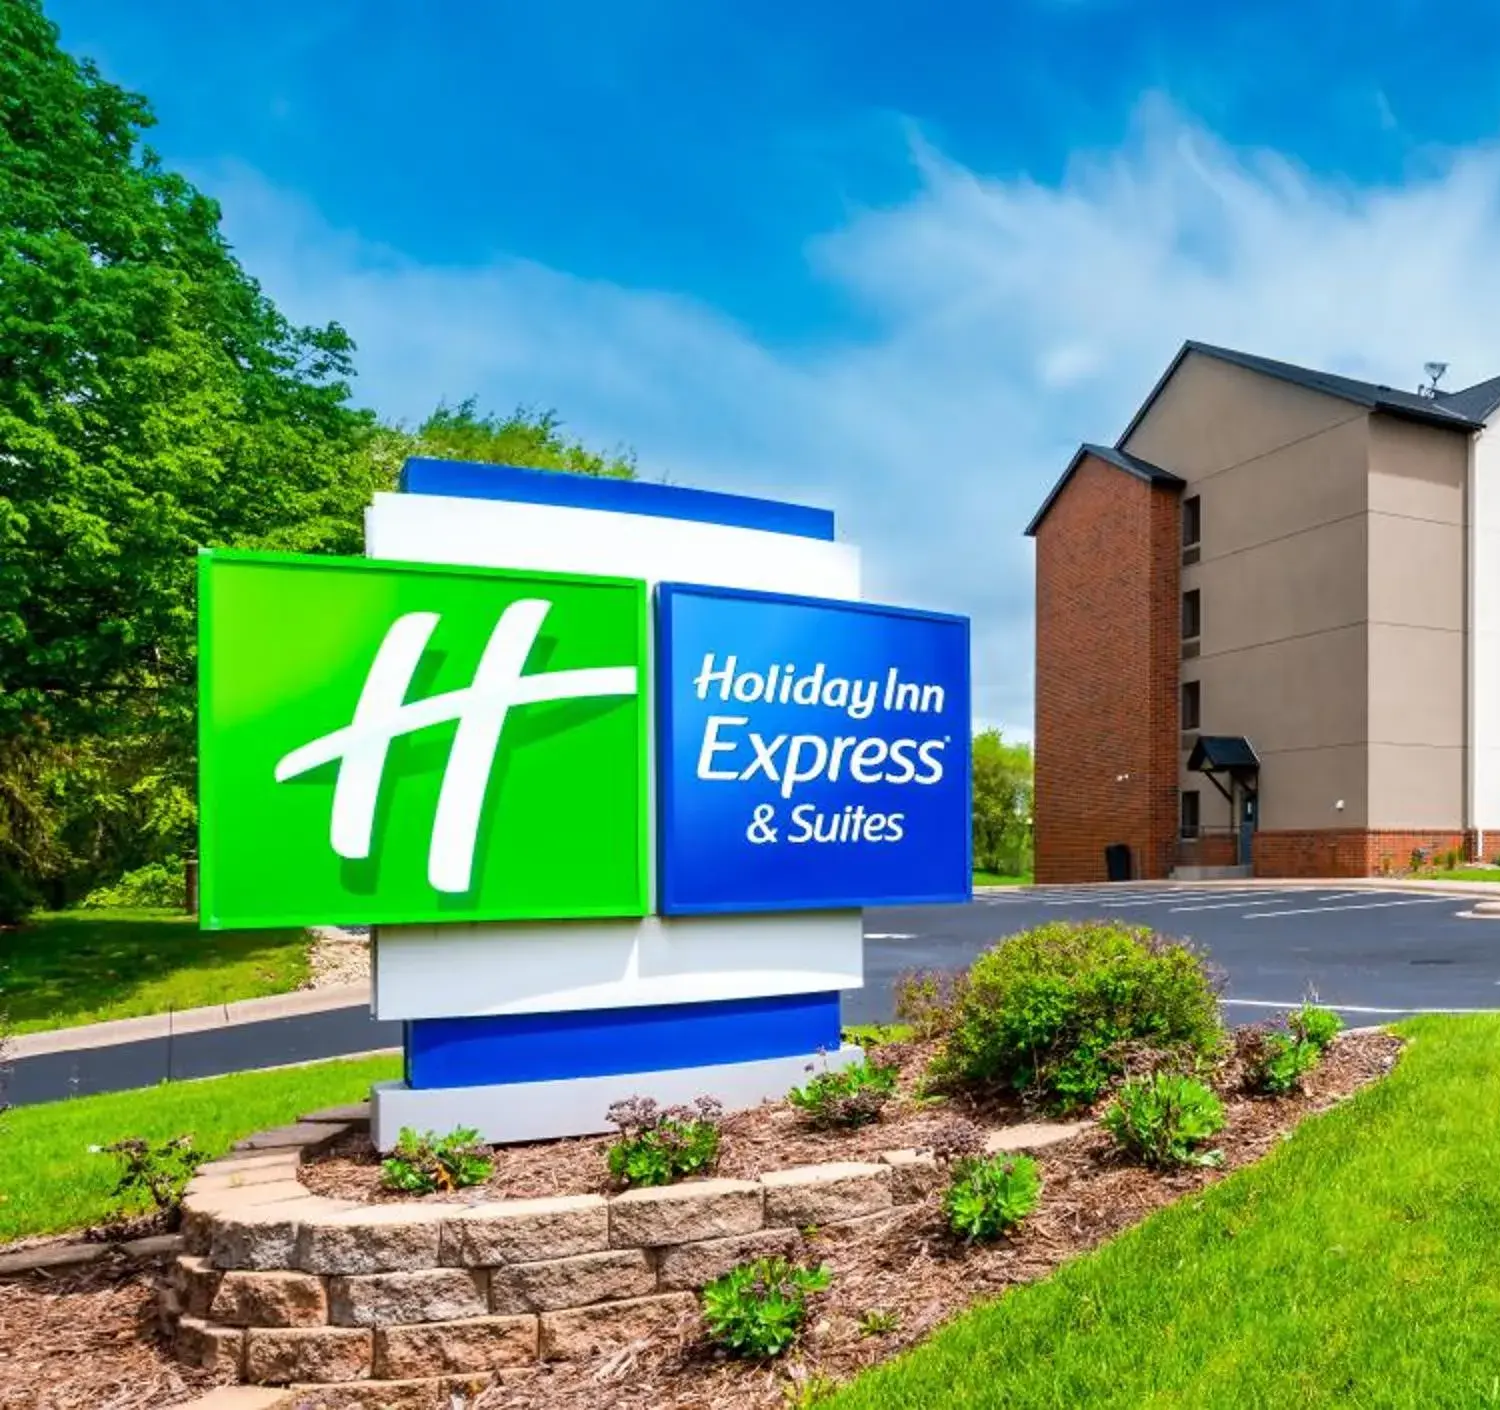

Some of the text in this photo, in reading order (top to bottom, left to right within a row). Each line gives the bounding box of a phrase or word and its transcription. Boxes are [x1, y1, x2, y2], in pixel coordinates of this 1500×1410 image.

[692, 652, 945, 719] Holiday Inn
[274, 598, 637, 893] H
[696, 714, 947, 798] Express
[746, 803, 905, 844] & Suites
